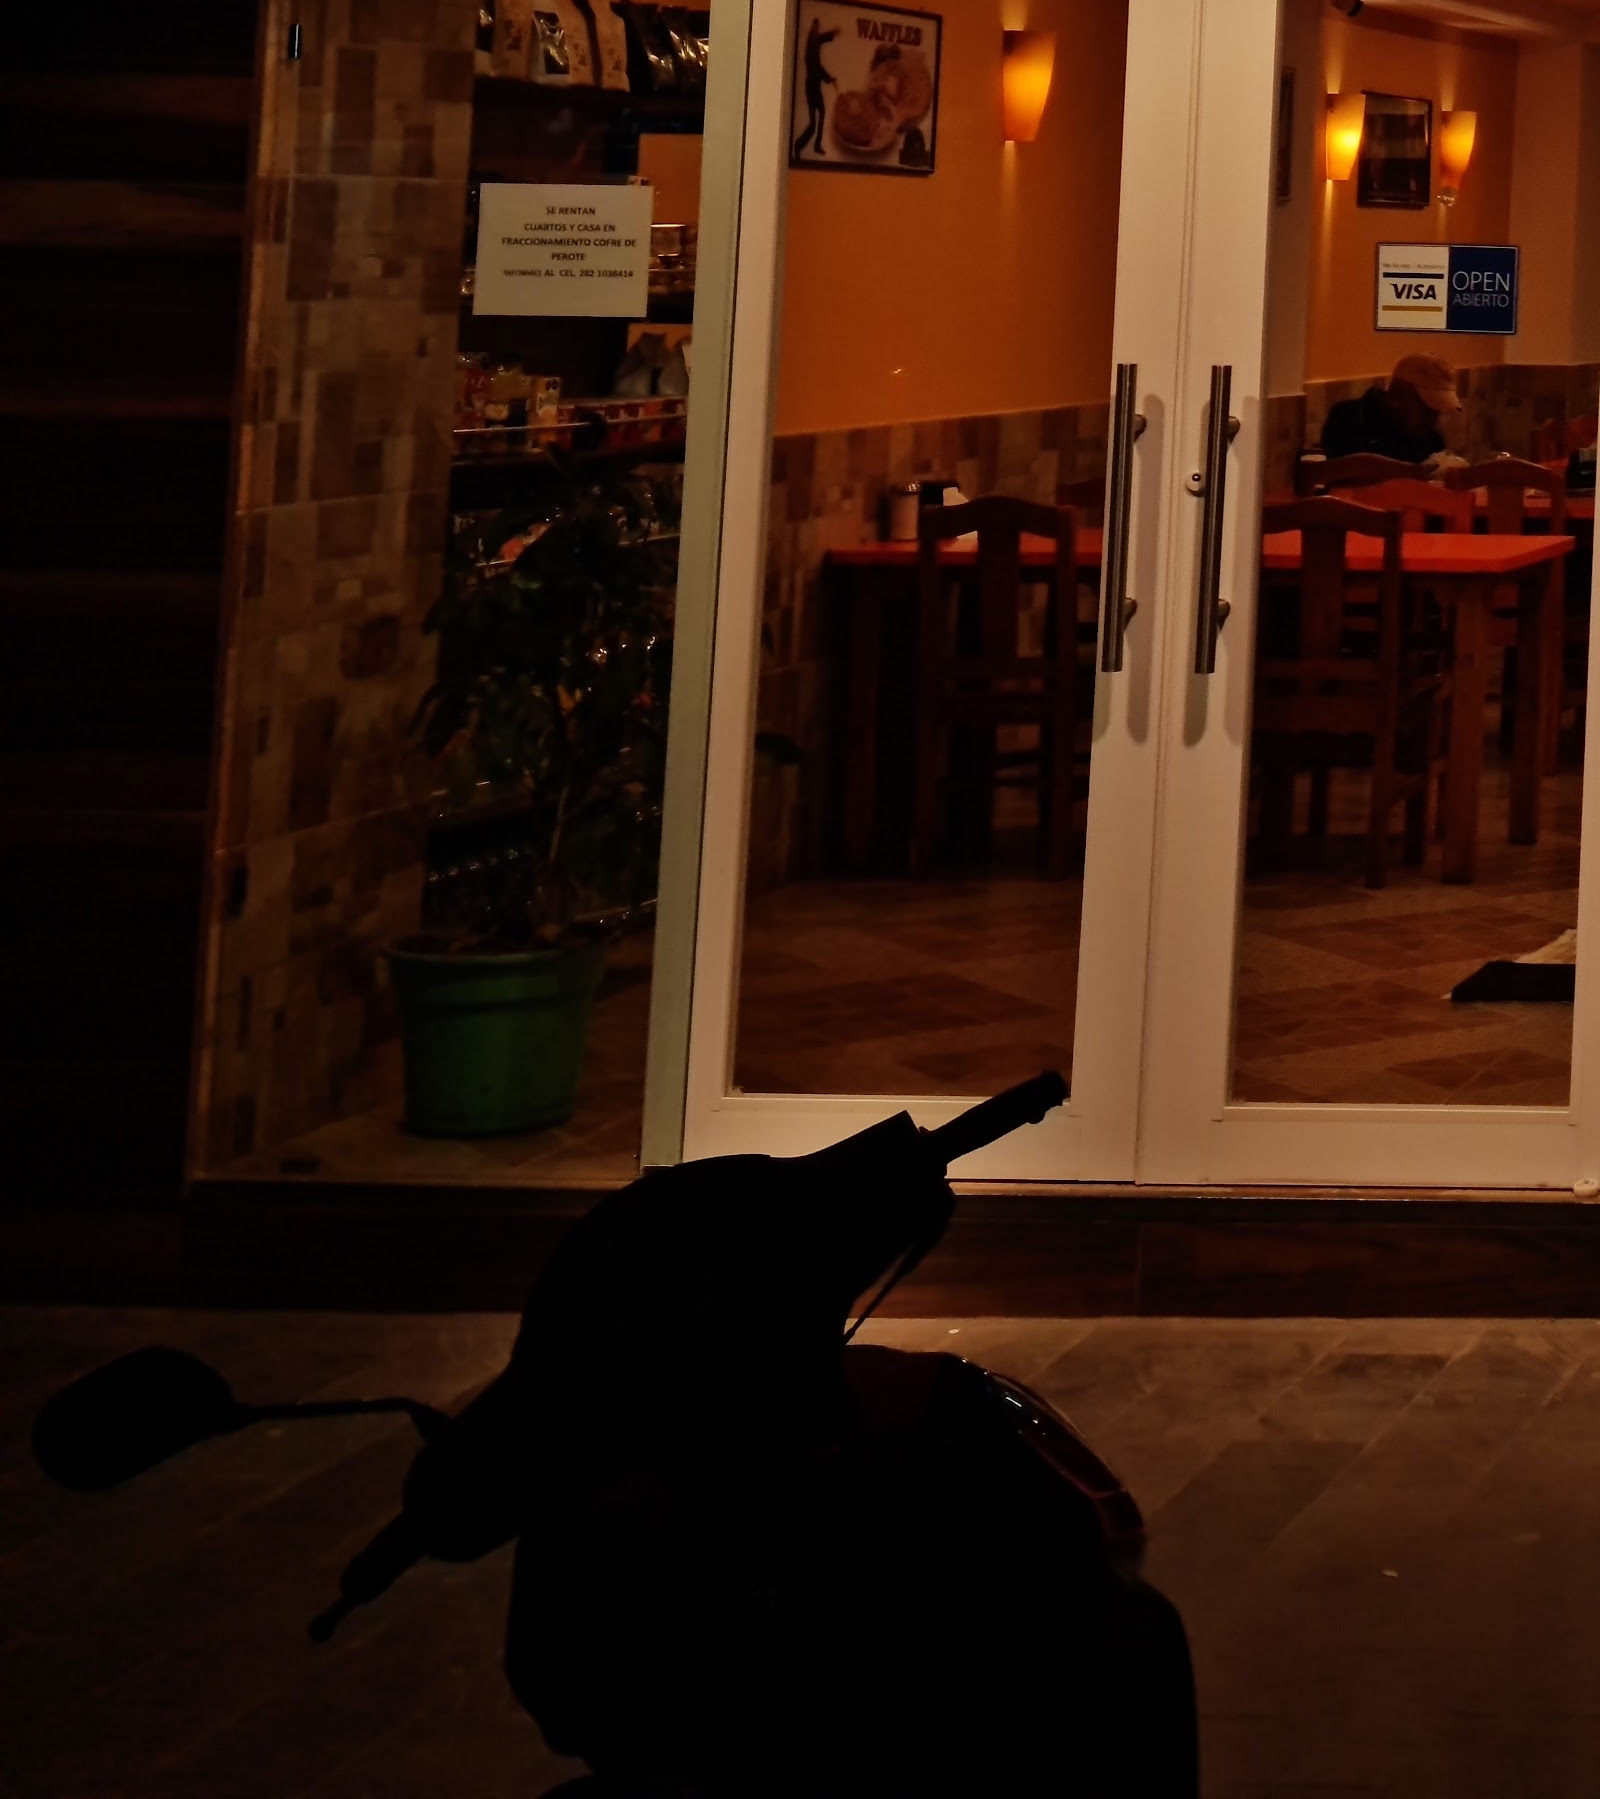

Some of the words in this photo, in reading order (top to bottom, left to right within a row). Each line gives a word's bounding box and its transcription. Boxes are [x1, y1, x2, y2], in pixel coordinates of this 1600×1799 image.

[856, 17, 922, 46] WAFFLES
[546, 206, 556, 216] SE
[558, 206, 596, 216] RENTAN
[524, 223, 568, 232] CUARTOS
[569, 224, 576, 232] Y
[577, 224, 602, 233] CASA
[603, 224, 616, 233] EN
[501, 237, 592, 247] FRACCIONAMIENTO
[593, 238, 623, 247] COFRE
[624, 238, 638, 248] DE
[551, 252, 587, 262] PEROTE
[544, 269, 556, 277] AL
[579, 269, 595, 277] 282
[1452, 270, 1511, 292] OPEN
[1390, 283, 1437, 300] VISA
[1452, 292, 1510, 308] ABIERTO
